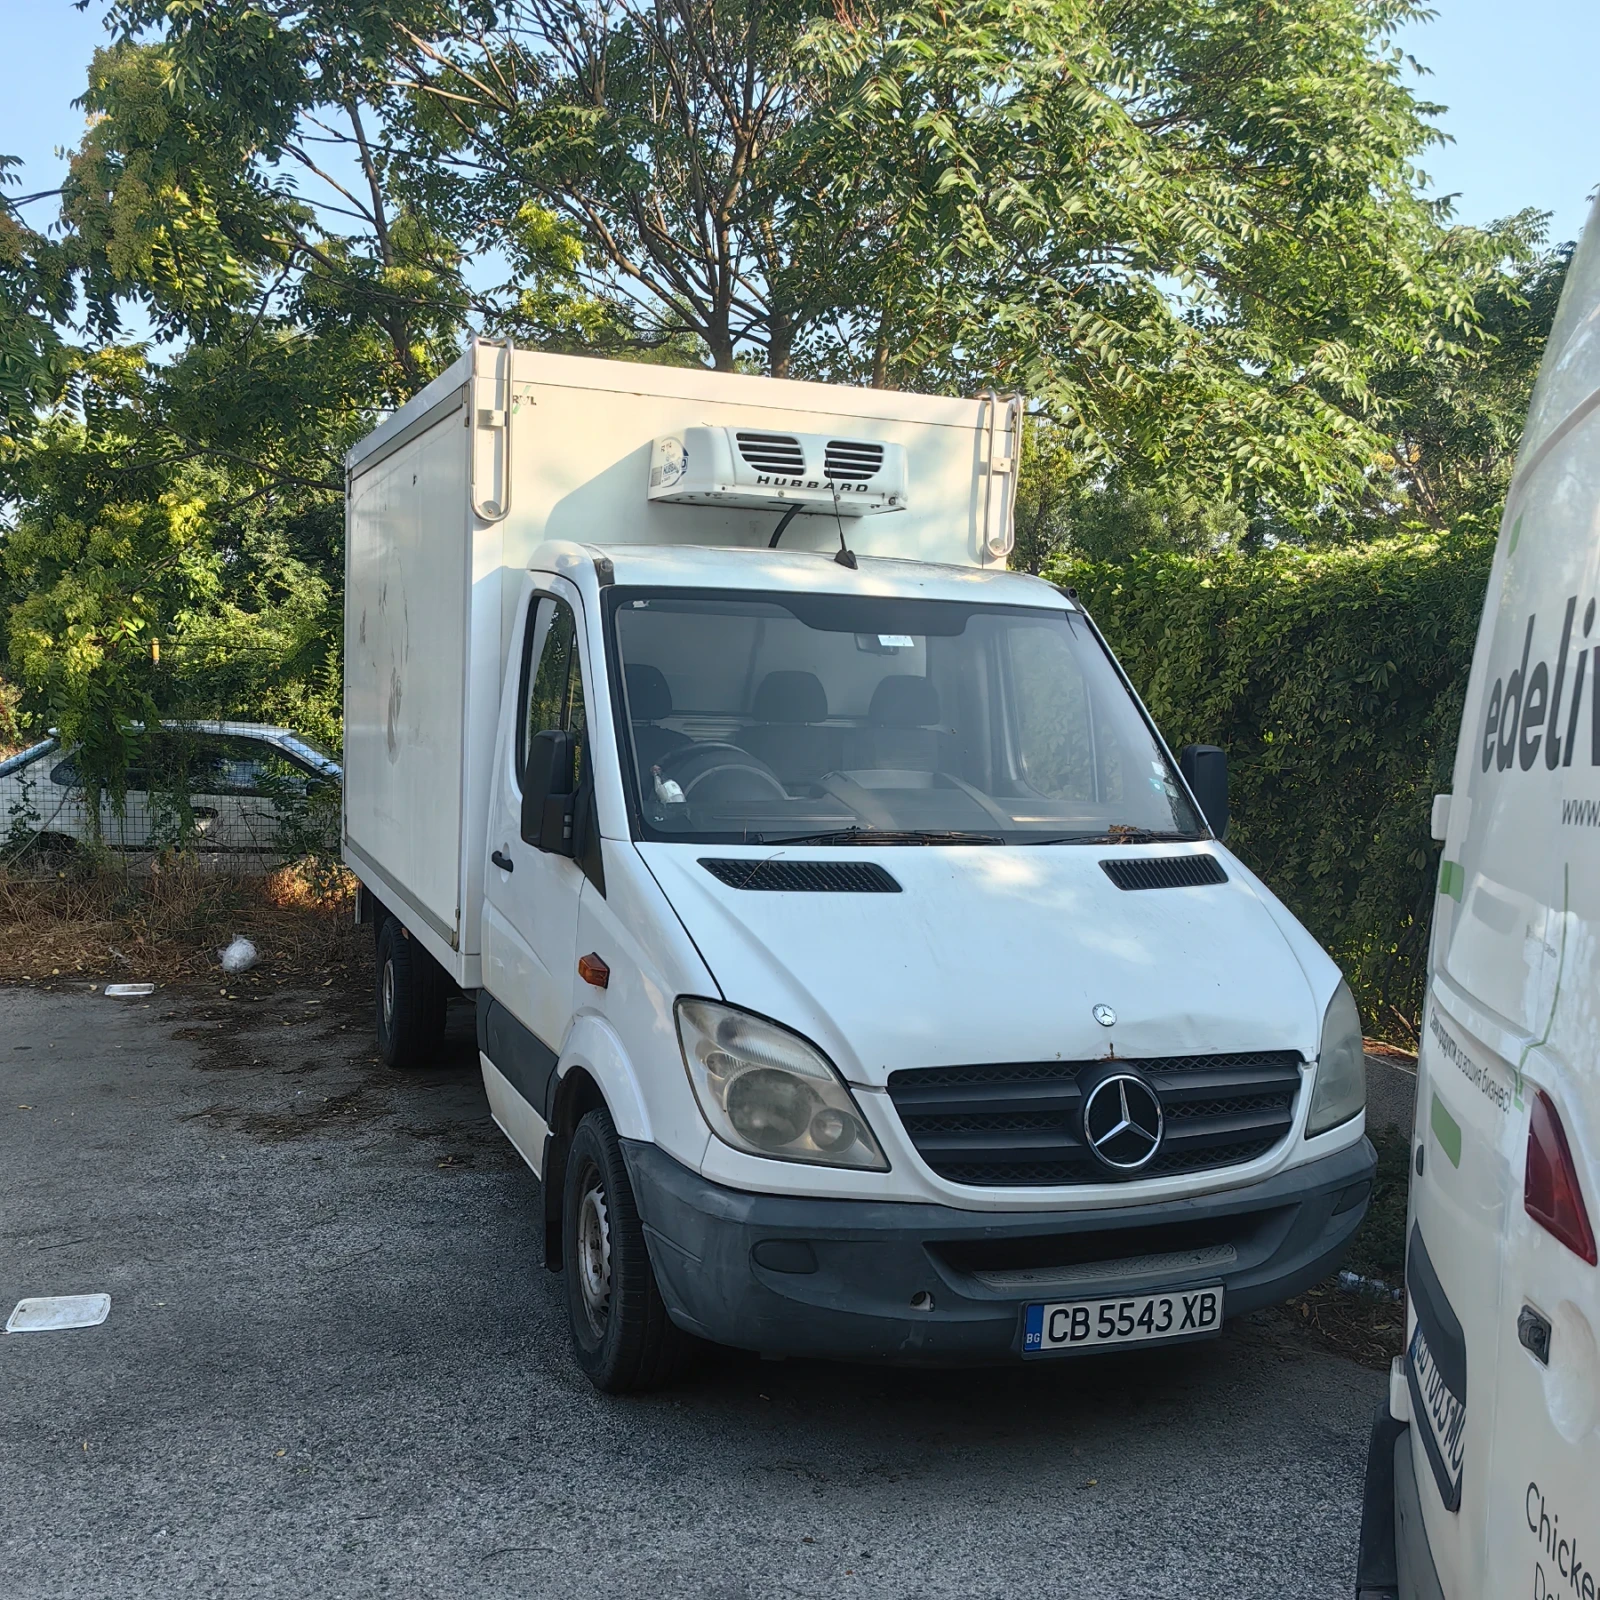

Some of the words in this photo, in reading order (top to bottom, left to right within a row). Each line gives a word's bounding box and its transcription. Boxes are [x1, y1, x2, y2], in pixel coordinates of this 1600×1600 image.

[756, 475, 869, 492] HUBBARD
[1481, 1067, 1512, 1115] бизнес!
[1026, 1333, 1040, 1344] BG
[1049, 1308, 1090, 1342] CB
[1098, 1300, 1173, 1338] 5543
[1180, 1293, 1216, 1329] XB
[1526, 1482, 1600, 1600] Chicke
